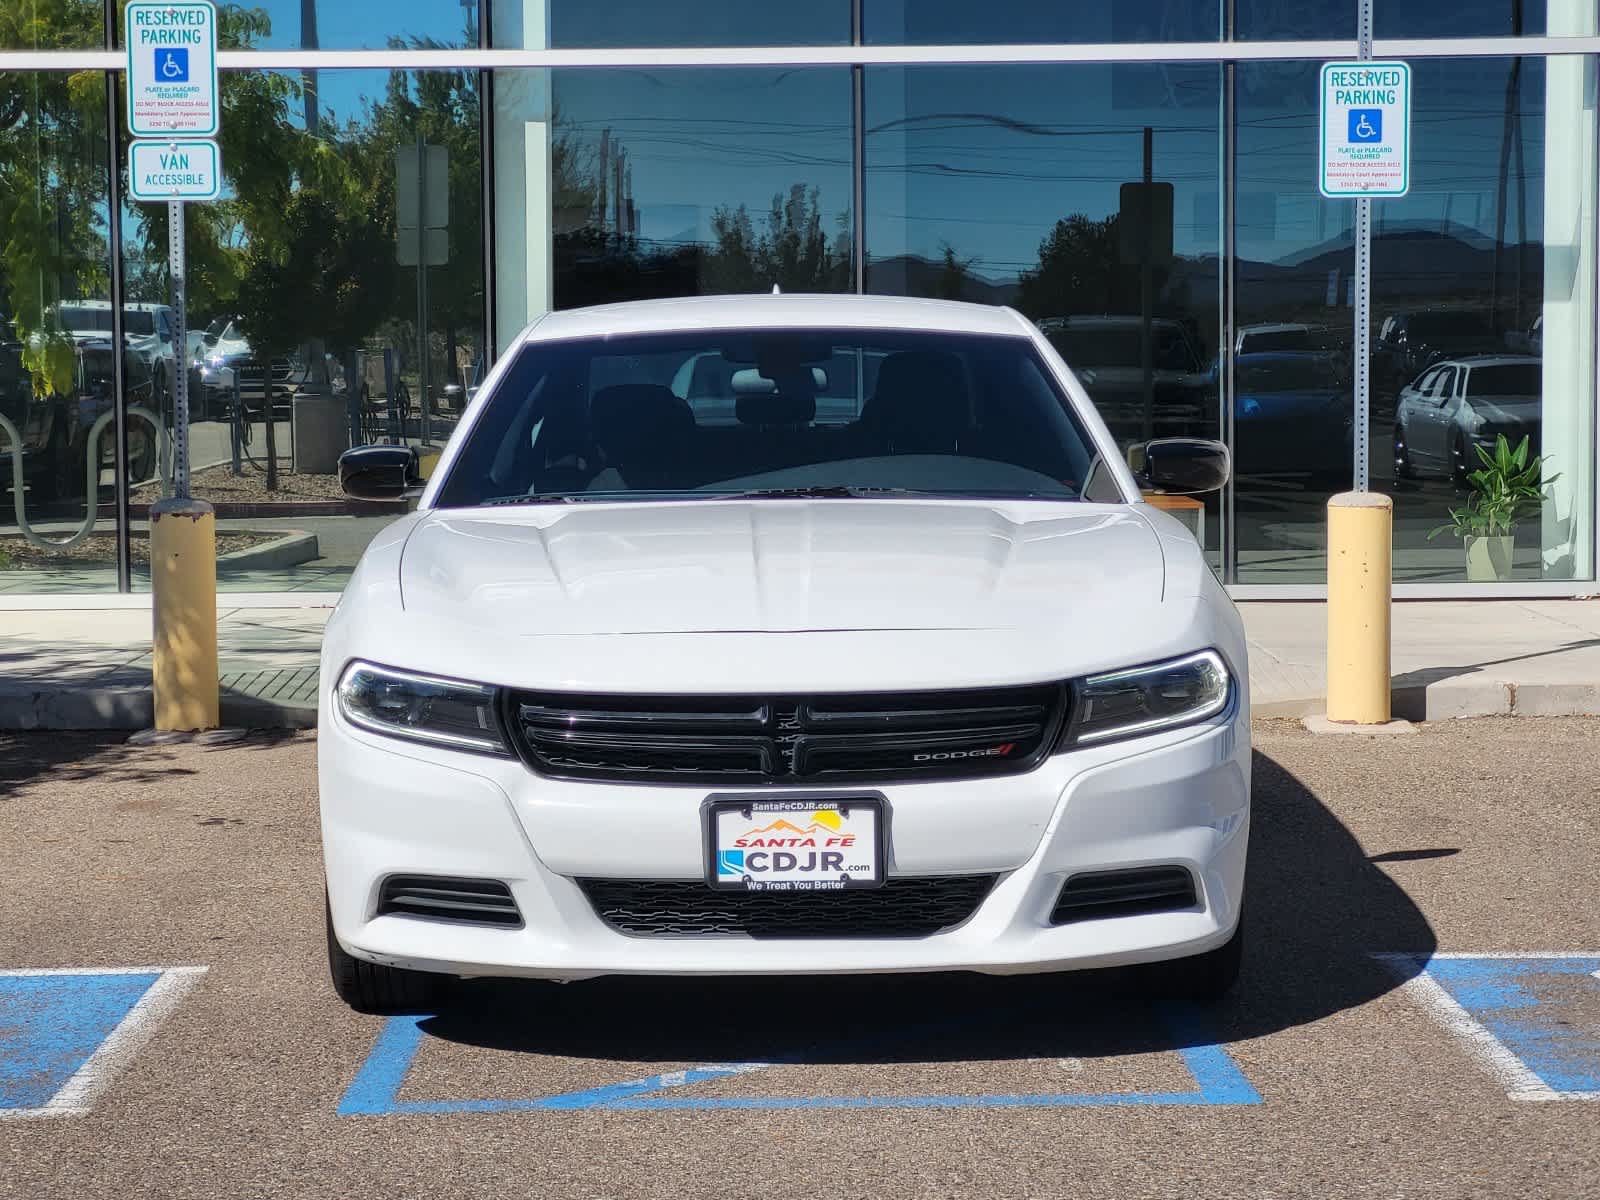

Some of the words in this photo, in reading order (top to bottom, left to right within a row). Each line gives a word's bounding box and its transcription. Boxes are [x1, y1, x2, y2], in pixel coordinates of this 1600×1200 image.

[136, 10, 205, 25] RESERVED
[141, 29, 201, 44] PARKING
[1331, 71, 1400, 87] RESERVED
[1336, 90, 1396, 105] PARKING
[160, 154, 189, 170] VAN
[145, 174, 205, 185] ACCESSIBLE
[914, 749, 1000, 760] DODGE
[752, 802, 838, 811] SantaFeCDJR.com
[734, 838, 816, 847] SANTA
[826, 837, 856, 847] FE
[747, 881, 762, 891] We
[765, 881, 791, 890] Treat
[794, 881, 812, 890] You
[814, 881, 846, 890] Better
